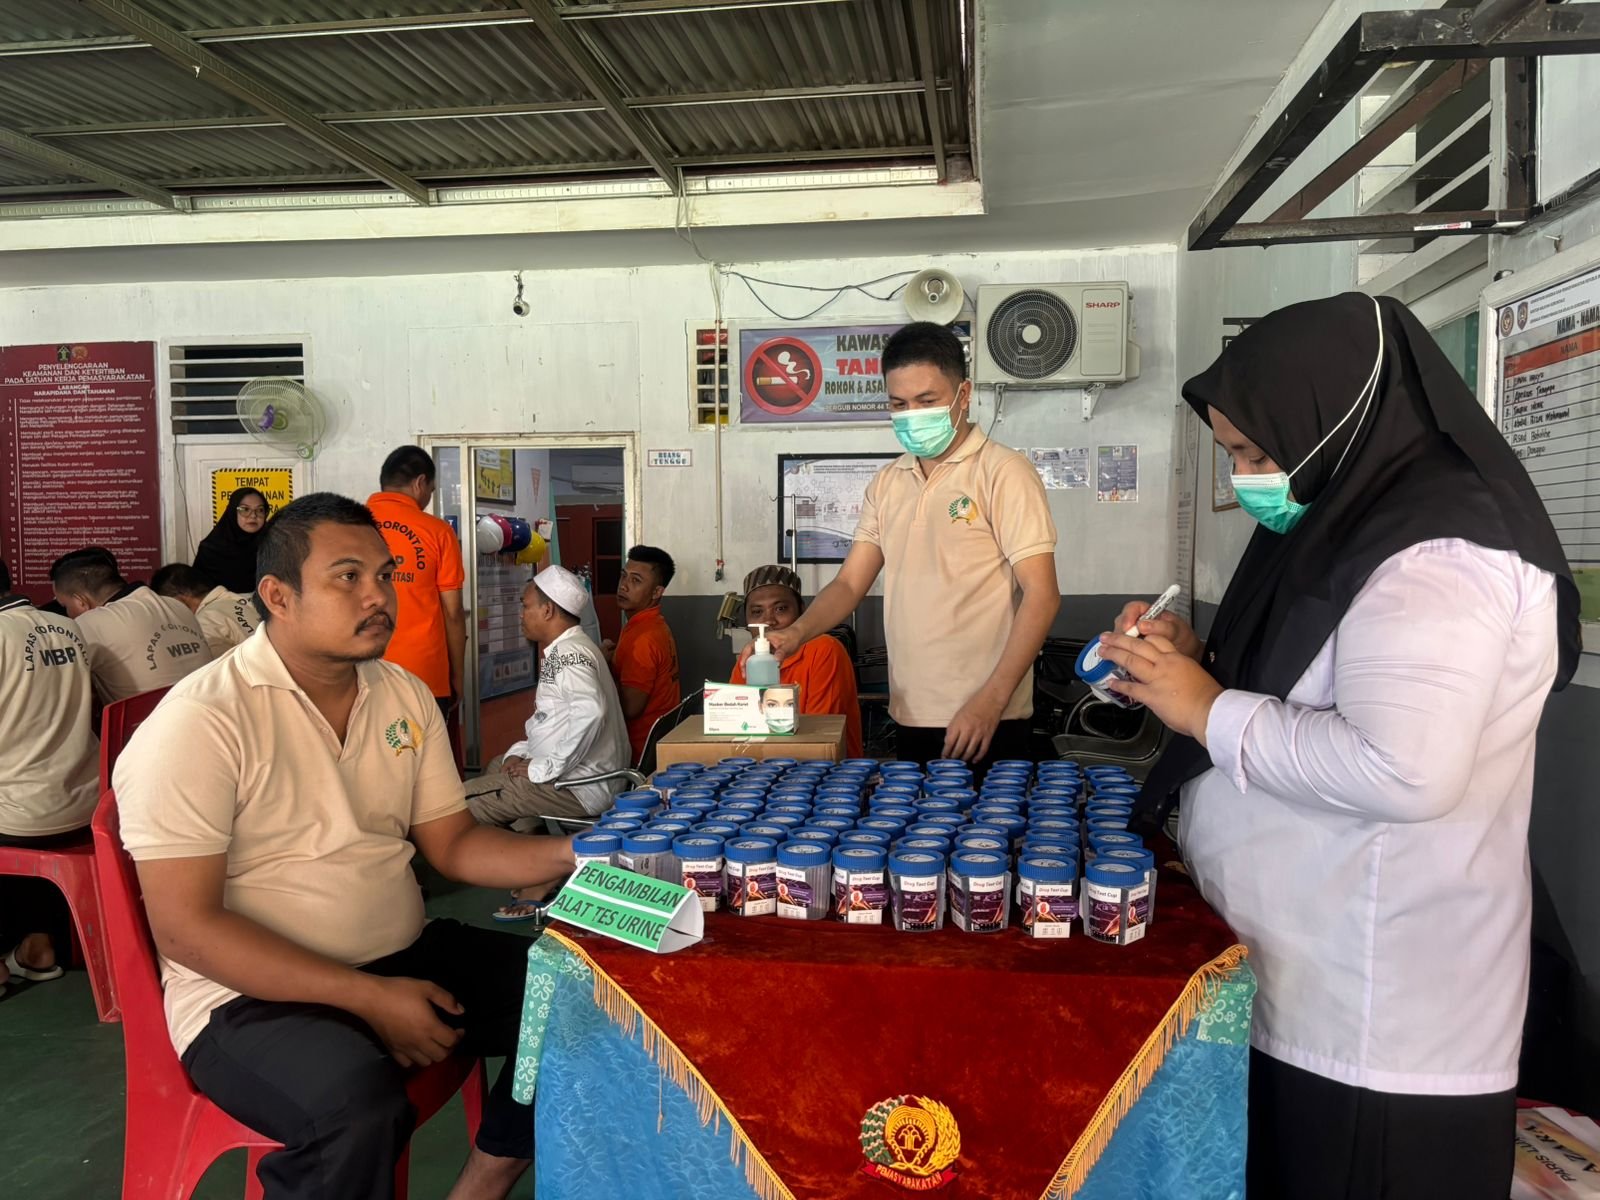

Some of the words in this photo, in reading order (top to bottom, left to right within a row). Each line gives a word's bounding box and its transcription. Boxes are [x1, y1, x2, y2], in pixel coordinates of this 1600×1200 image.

[836, 358, 882, 376] TAN
[825, 380, 854, 395] ROKOK
[857, 382, 862, 393] &
[852, 403, 876, 411] NOMOR
[235, 477, 270, 486] TEMPAT
[376, 520, 426, 570] GORONTALO
[234, 606, 254, 633] LAPAS
[25, 632, 37, 671] LAPAS
[39, 646, 76, 666] WBP
[146, 632, 161, 670] LAPAS
[166, 642, 200, 657] WBP
[576, 866, 685, 908] PENGAMBILAN
[554, 894, 592, 918] ALAT
[591, 906, 614, 926] TES
[618, 914, 665, 942] URINE
